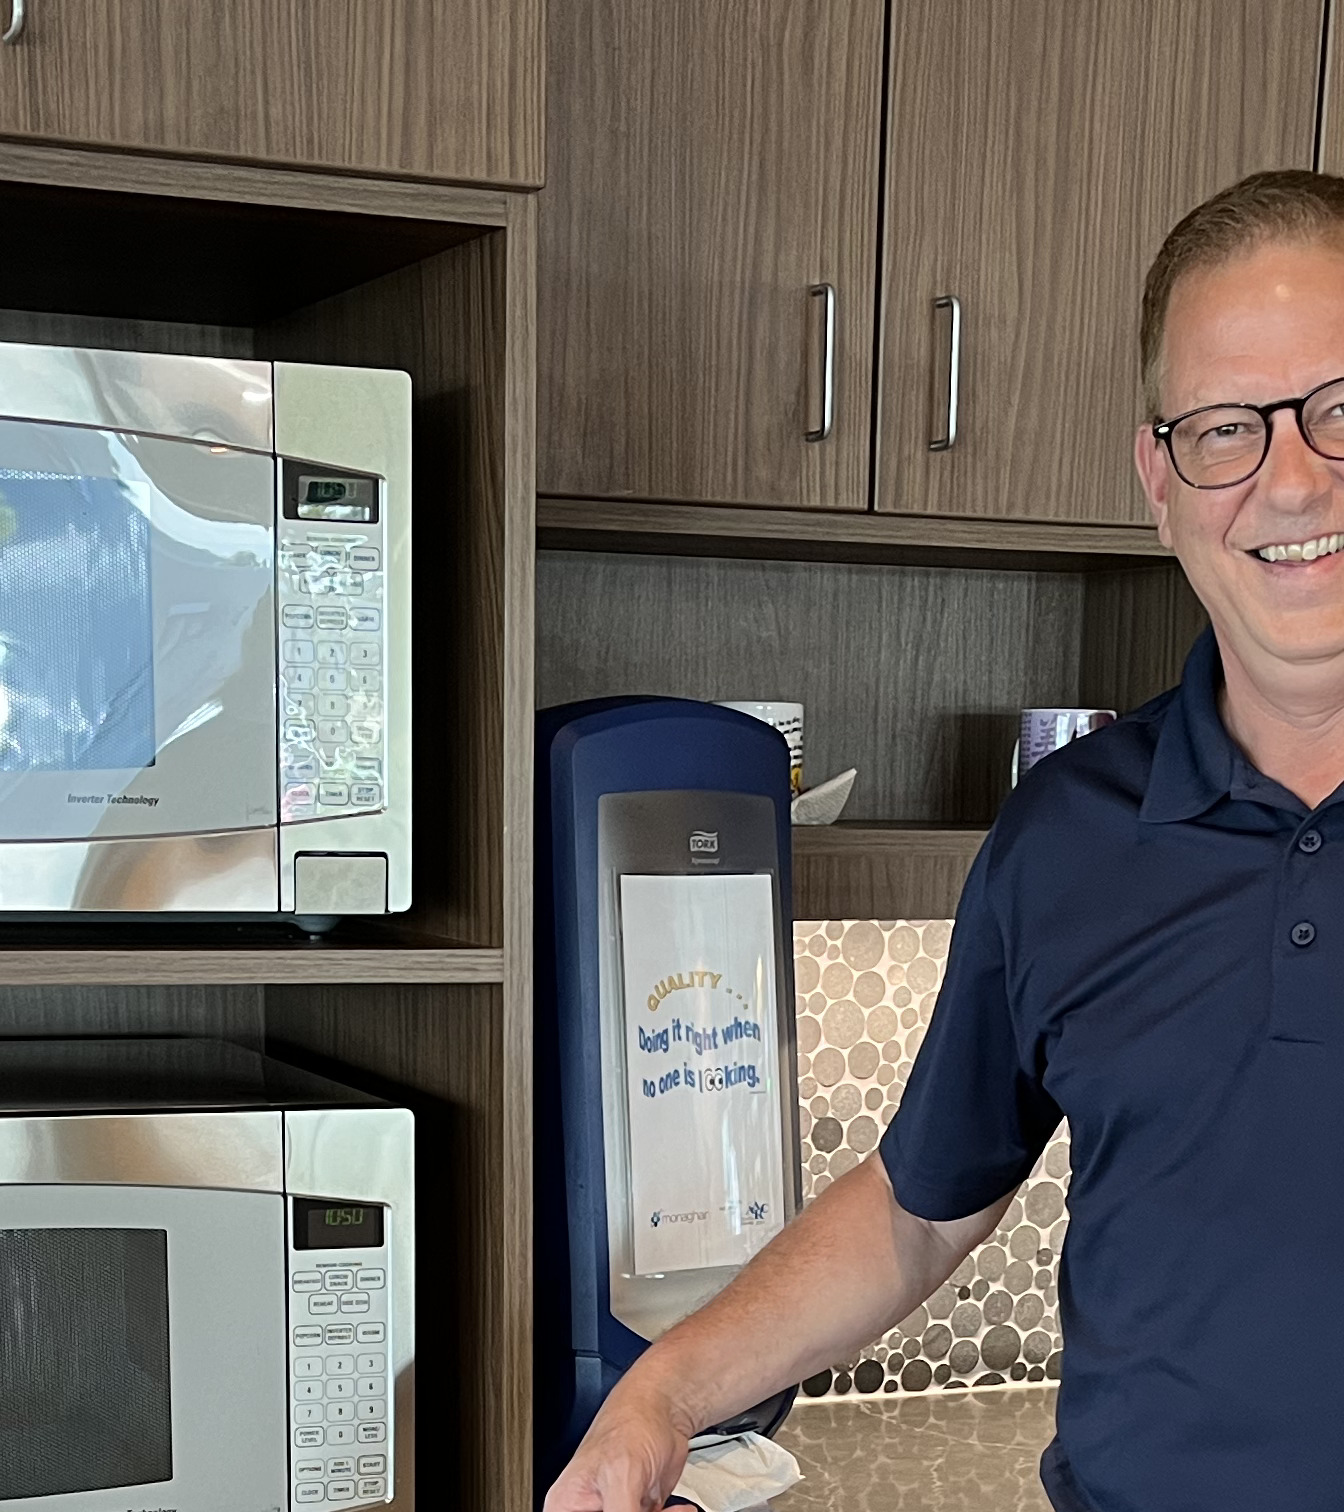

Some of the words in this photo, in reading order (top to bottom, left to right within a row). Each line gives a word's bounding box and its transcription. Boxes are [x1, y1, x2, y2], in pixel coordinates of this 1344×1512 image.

[67, 793, 104, 804] Inverter
[107, 794, 160, 807] Technology
[647, 971, 722, 1012] QUALITY
[638, 1025, 669, 1053] Doing
[672, 1017, 682, 1042] it
[685, 1022, 718, 1056] right
[722, 1016, 761, 1045] when
[643, 1078, 656, 1098] no
[659, 1069, 680, 1094] one
[684, 1062, 695, 1088] is
